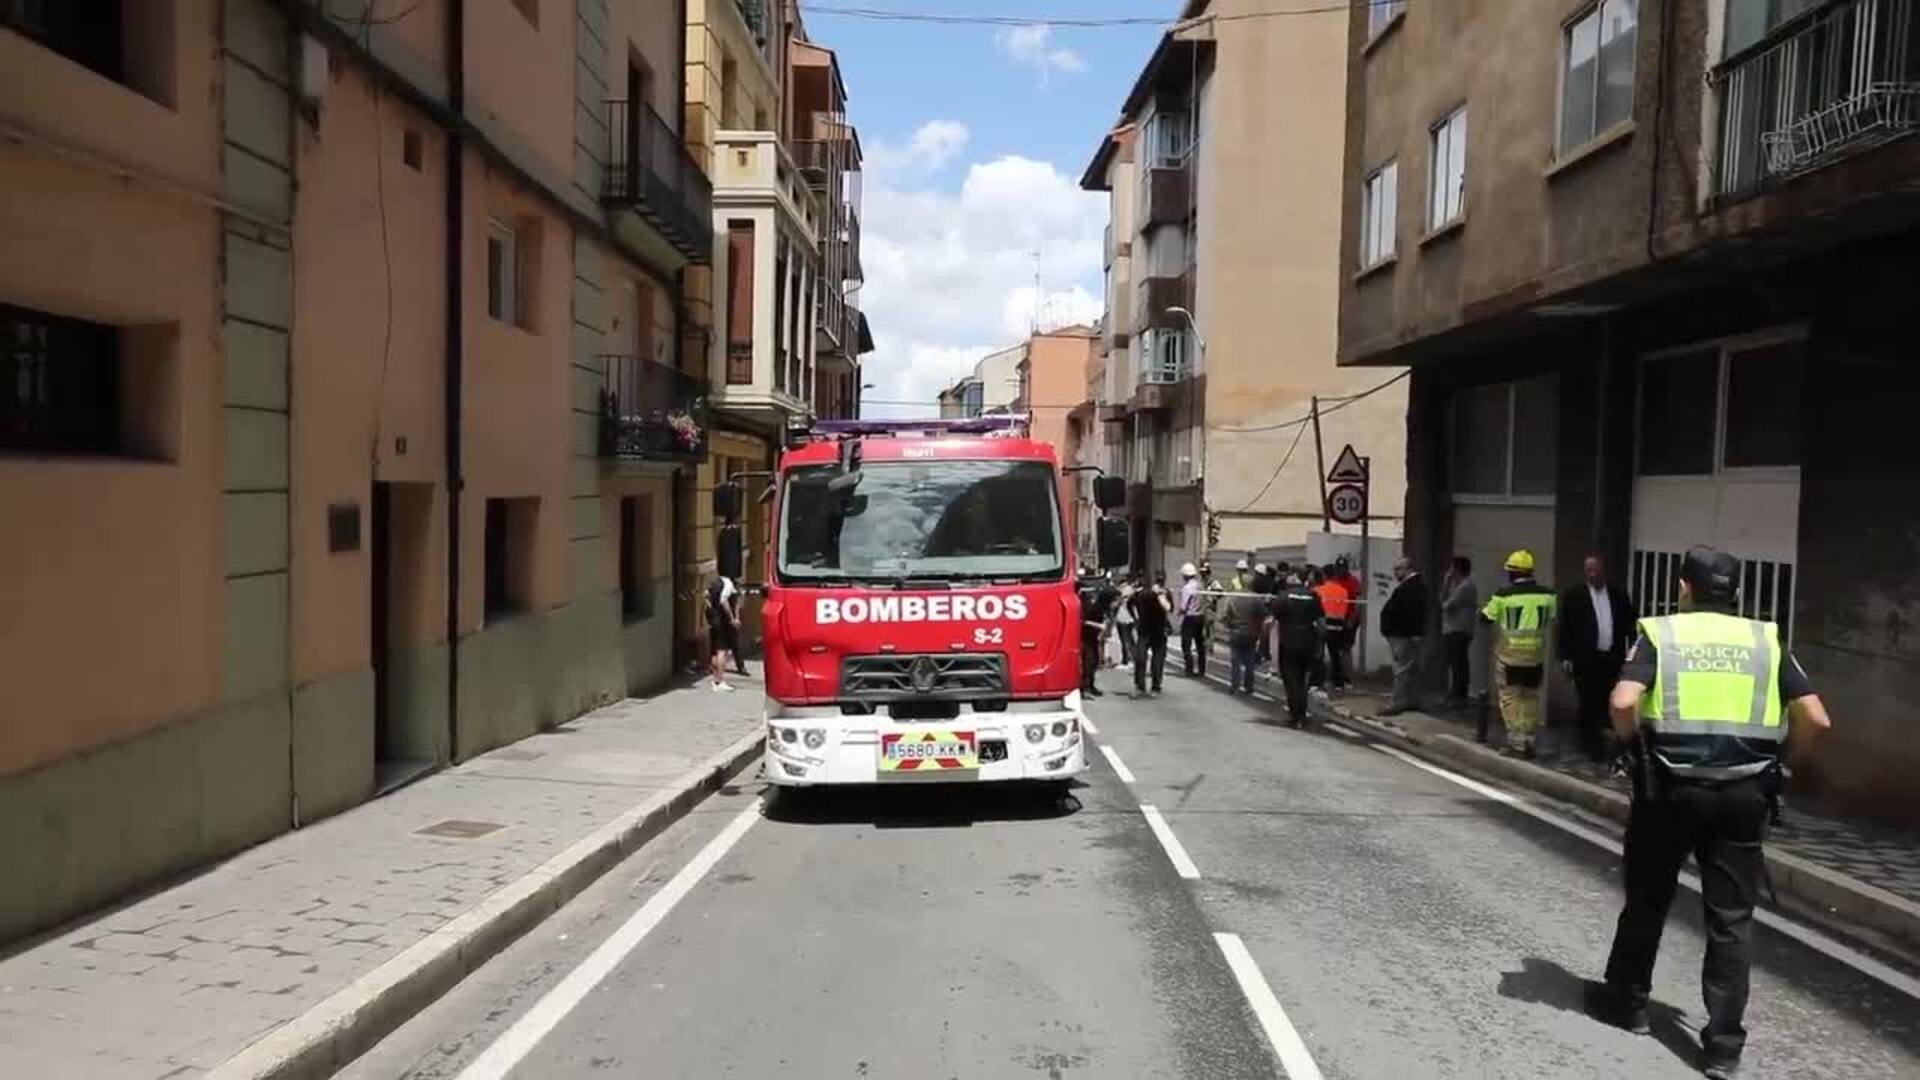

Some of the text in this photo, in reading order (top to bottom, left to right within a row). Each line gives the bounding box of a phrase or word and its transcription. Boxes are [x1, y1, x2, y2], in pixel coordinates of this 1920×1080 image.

[1336, 497, 1360, 512] 30
[816, 594, 1028, 624] BOMBEROS
[974, 627, 1003, 644] S-2
[1688, 658, 1741, 672] LOCAL
